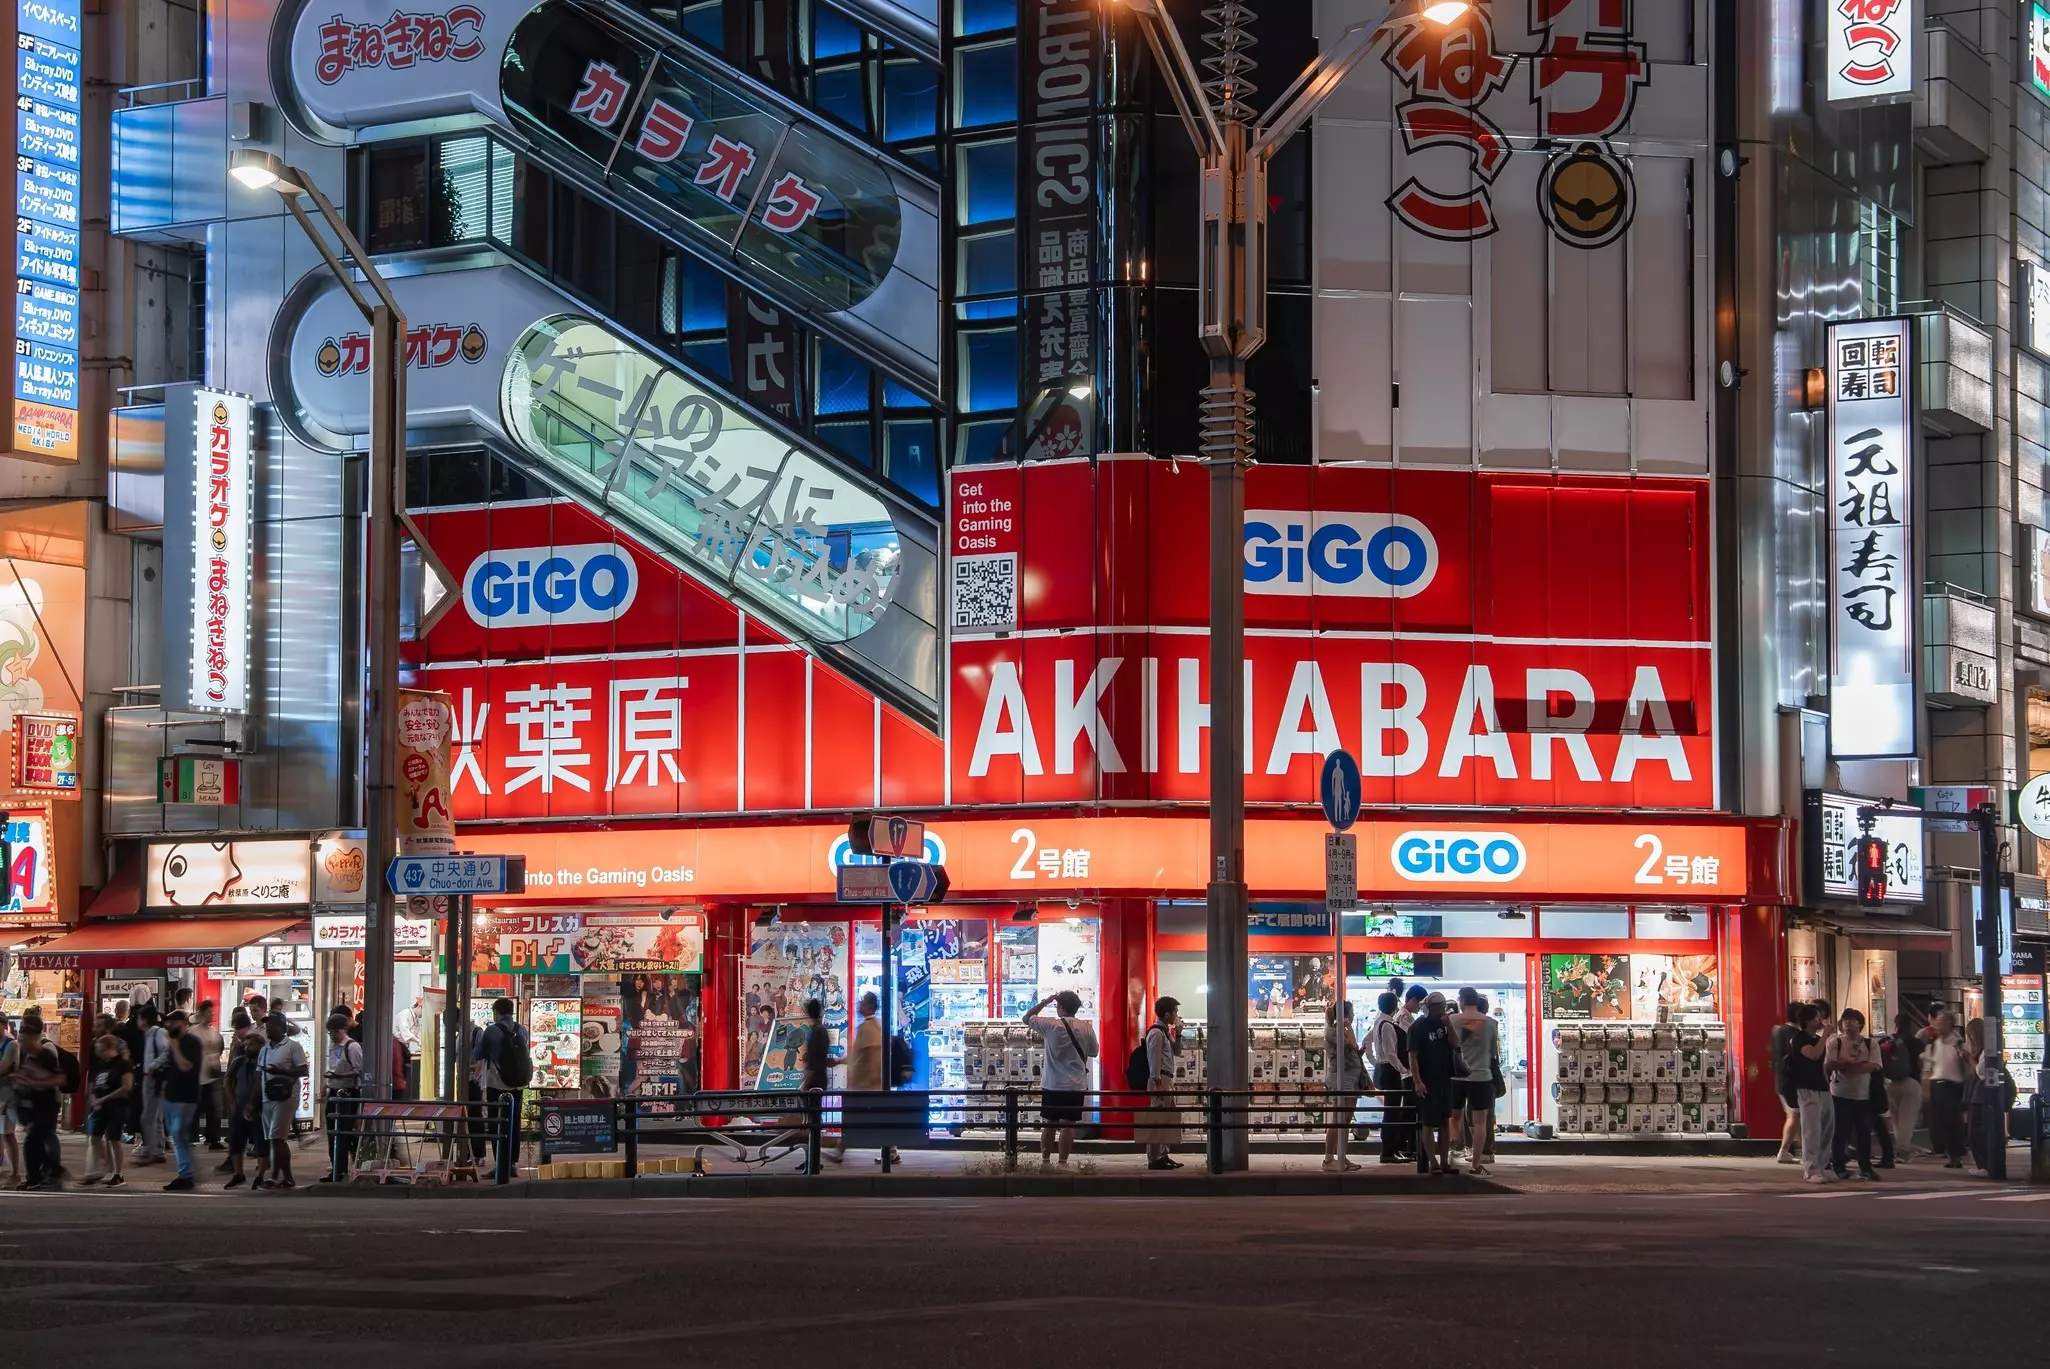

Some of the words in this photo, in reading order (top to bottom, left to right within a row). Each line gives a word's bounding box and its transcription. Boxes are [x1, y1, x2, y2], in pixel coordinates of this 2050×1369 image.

[18, 33, 34, 50] 5F
[315, 5, 485, 86] まねきねこ
[17, 96, 33, 111] 4F
[570, 58, 822, 234] カラオケ
[17, 156, 33, 172] 3F
[16, 217, 32, 233] 2F
[17, 278, 32, 294] 1F
[16, 339, 31, 357] B1
[341, 323, 466, 377] カオケ
[1841, 339, 1897, 368] 回転
[1841, 370, 1897, 398] 寿司
[530, 340, 724, 453] ゲームの
[17, 424, 41, 436] MEDIA
[32, 437, 56, 449] AKIBA
[210, 425, 231, 528] カラオケ
[596, 438, 835, 538] オアシスに
[959, 482, 983, 497] Get
[963, 500, 987, 514] into
[990, 498, 1012, 513] the
[959, 516, 1012, 533] Gaming
[1838, 427, 1900, 631] 元祖寿司
[959, 534, 997, 550] Oasis
[1243, 519, 1428, 587] GiGO
[470, 551, 631, 618] GiGO
[206, 554, 231, 703] まねきねこ
[968, 656, 1692, 783] AKIHABARA
[28, 723, 52, 737] DVD
[1009, 828, 1090, 881] 2号館
[1400, 838, 1518, 875] GiGO
[1633, 833, 1720, 887] 2号館
[404, 869, 423, 882] 437
[432, 860, 491, 877] 中央通り
[524, 869, 553, 886] into
[556, 868, 583, 885] the
[586, 866, 647, 888] Gaming
[650, 865, 694, 883] Oasis
[228, 888, 249, 897] 秋葉原
[250, 884, 289, 899] くりこ庵
[429, 877, 473, 889] Chuo-dori
[476, 878, 494, 888] Ave.
[1331, 886, 1352, 897] 13-17
[521, 915, 579, 933] フレスカ
[22, 955, 79, 968] TAIYAKI
[511, 939, 539, 969] B1
[641, 1082, 678, 1096] 地下1F
